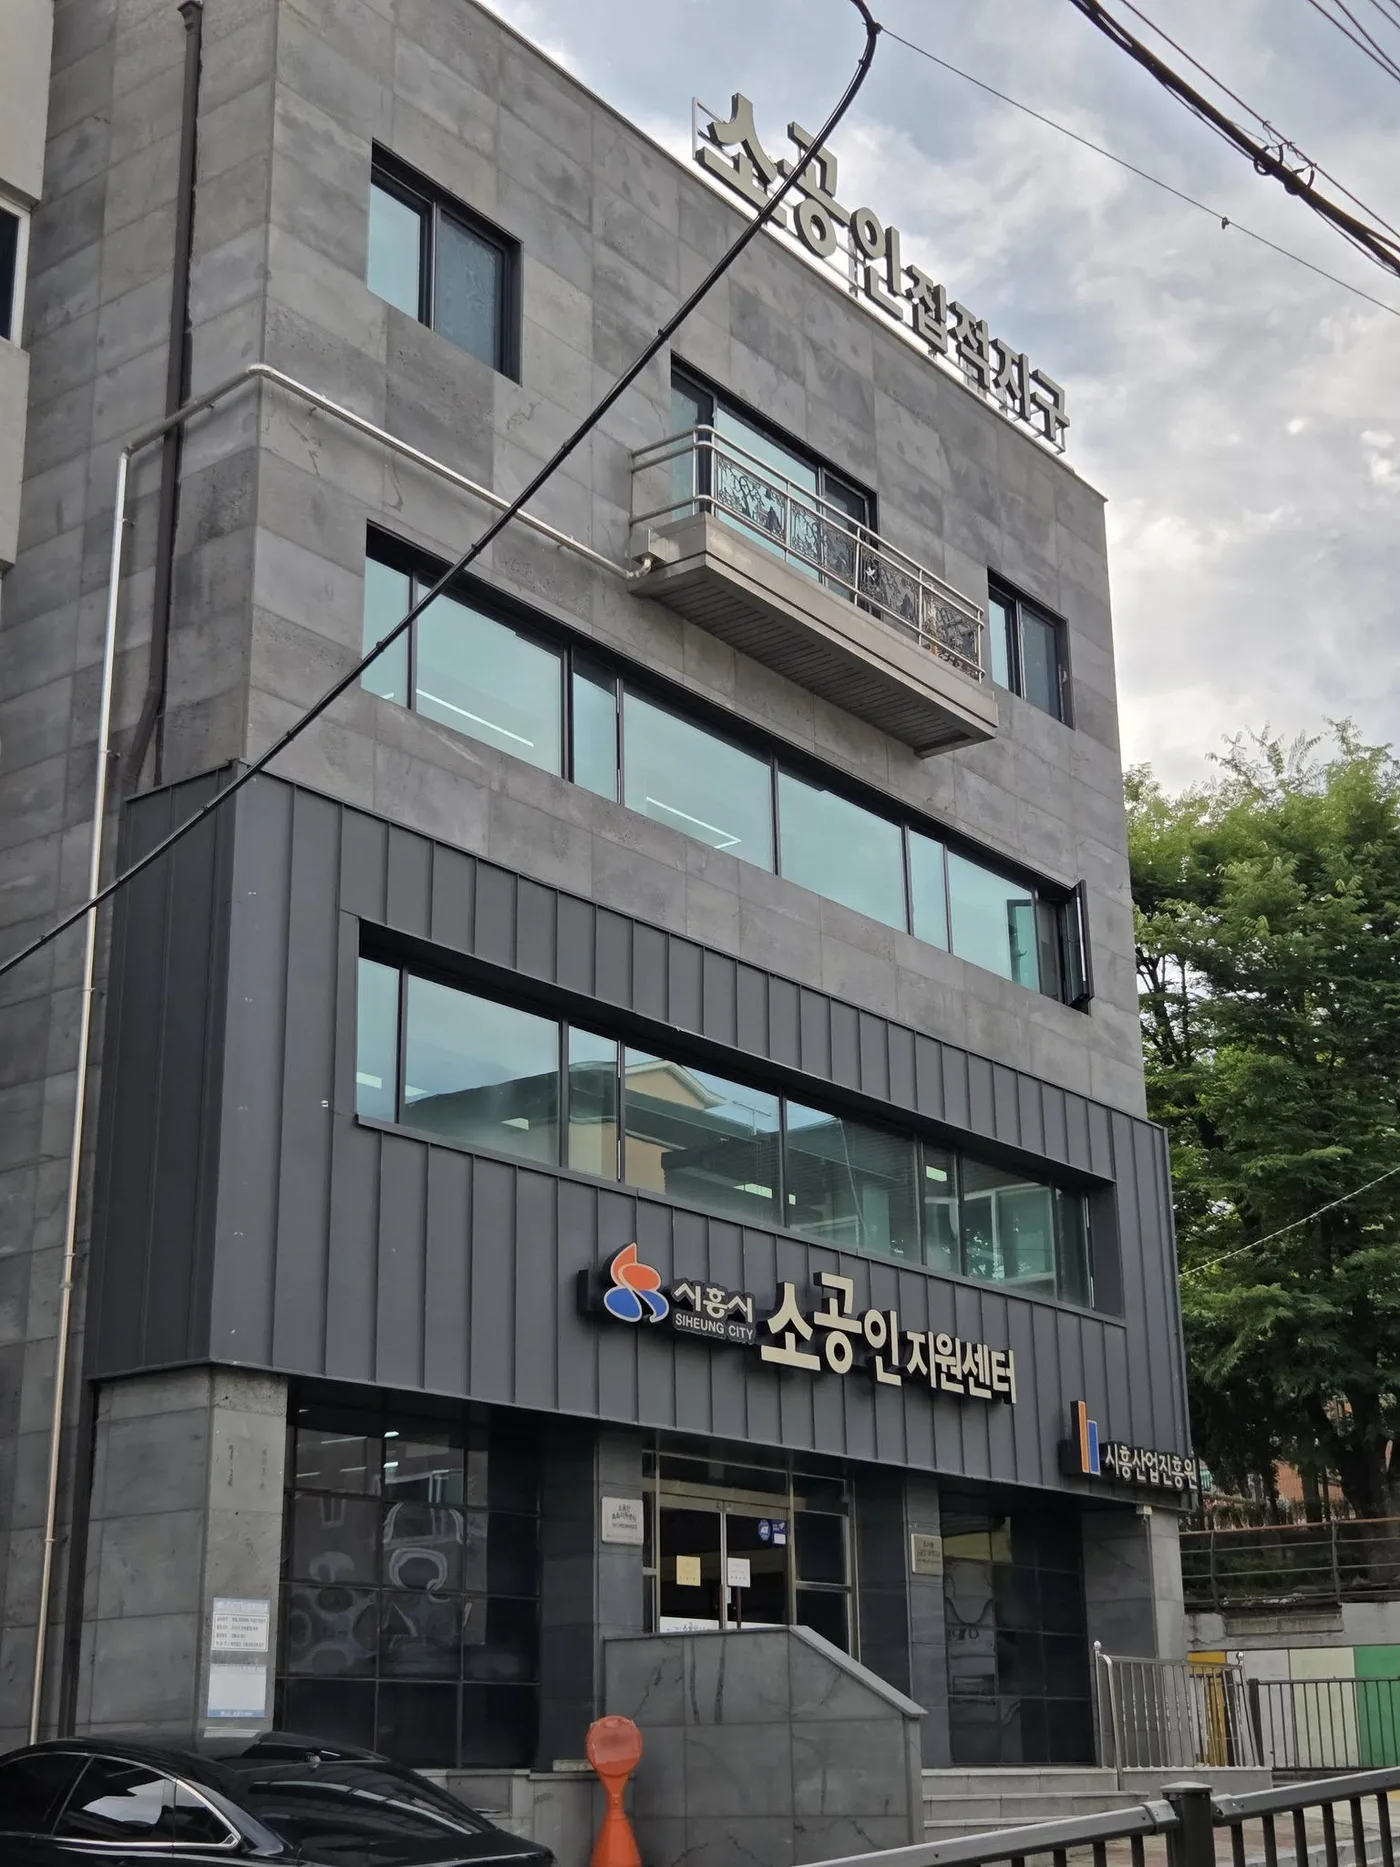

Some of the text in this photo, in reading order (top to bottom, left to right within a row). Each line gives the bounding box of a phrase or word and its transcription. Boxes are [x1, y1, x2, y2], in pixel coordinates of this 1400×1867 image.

[673, 1282, 754, 1323] 시흥시
[675, 1313, 753, 1340] SIHEUNG CITY
[1104, 1443, 1198, 1491] 시흥산업진흥원
